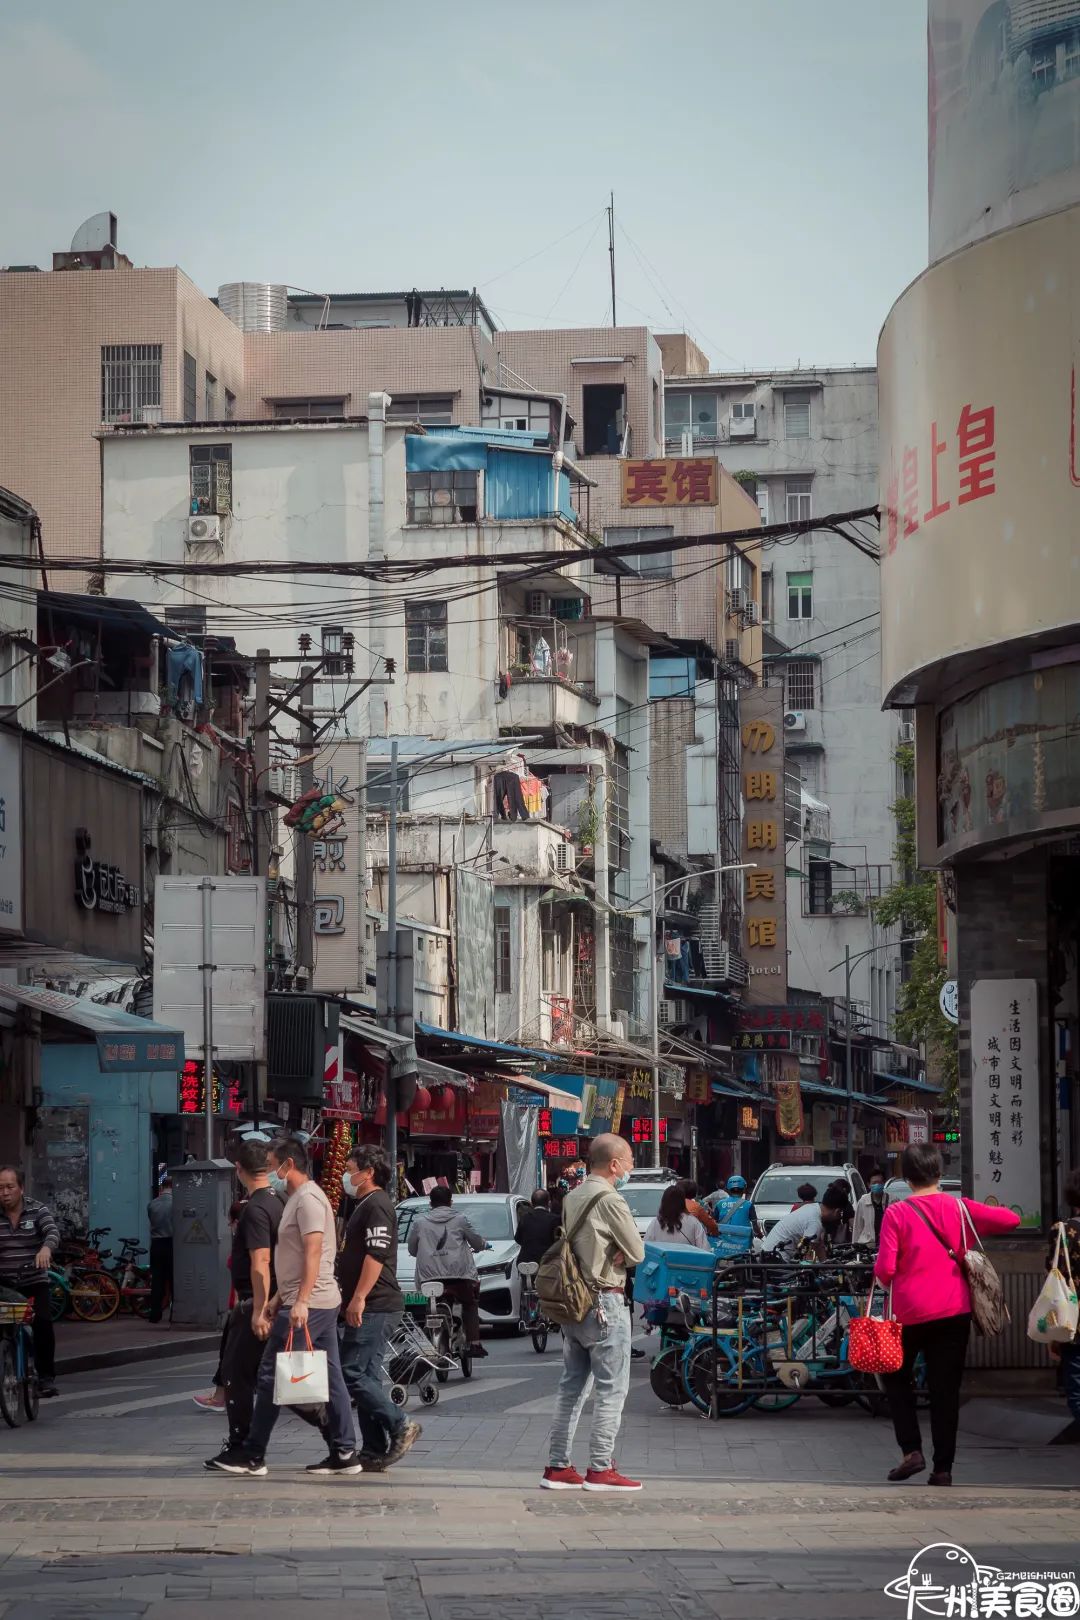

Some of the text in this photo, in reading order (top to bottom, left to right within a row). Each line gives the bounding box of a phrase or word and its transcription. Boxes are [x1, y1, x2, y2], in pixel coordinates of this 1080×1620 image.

[627, 460, 713, 504] 宾馆
[313, 765, 355, 934] 水煎包
[746, 771, 778, 948] 朗朗宾馆
[987, 1036, 1004, 1183] 城市因文明有魅力
[1009, 999, 1024, 1147] 生活因文明而精彩
[544, 1140, 577, 1157] 烟酒
